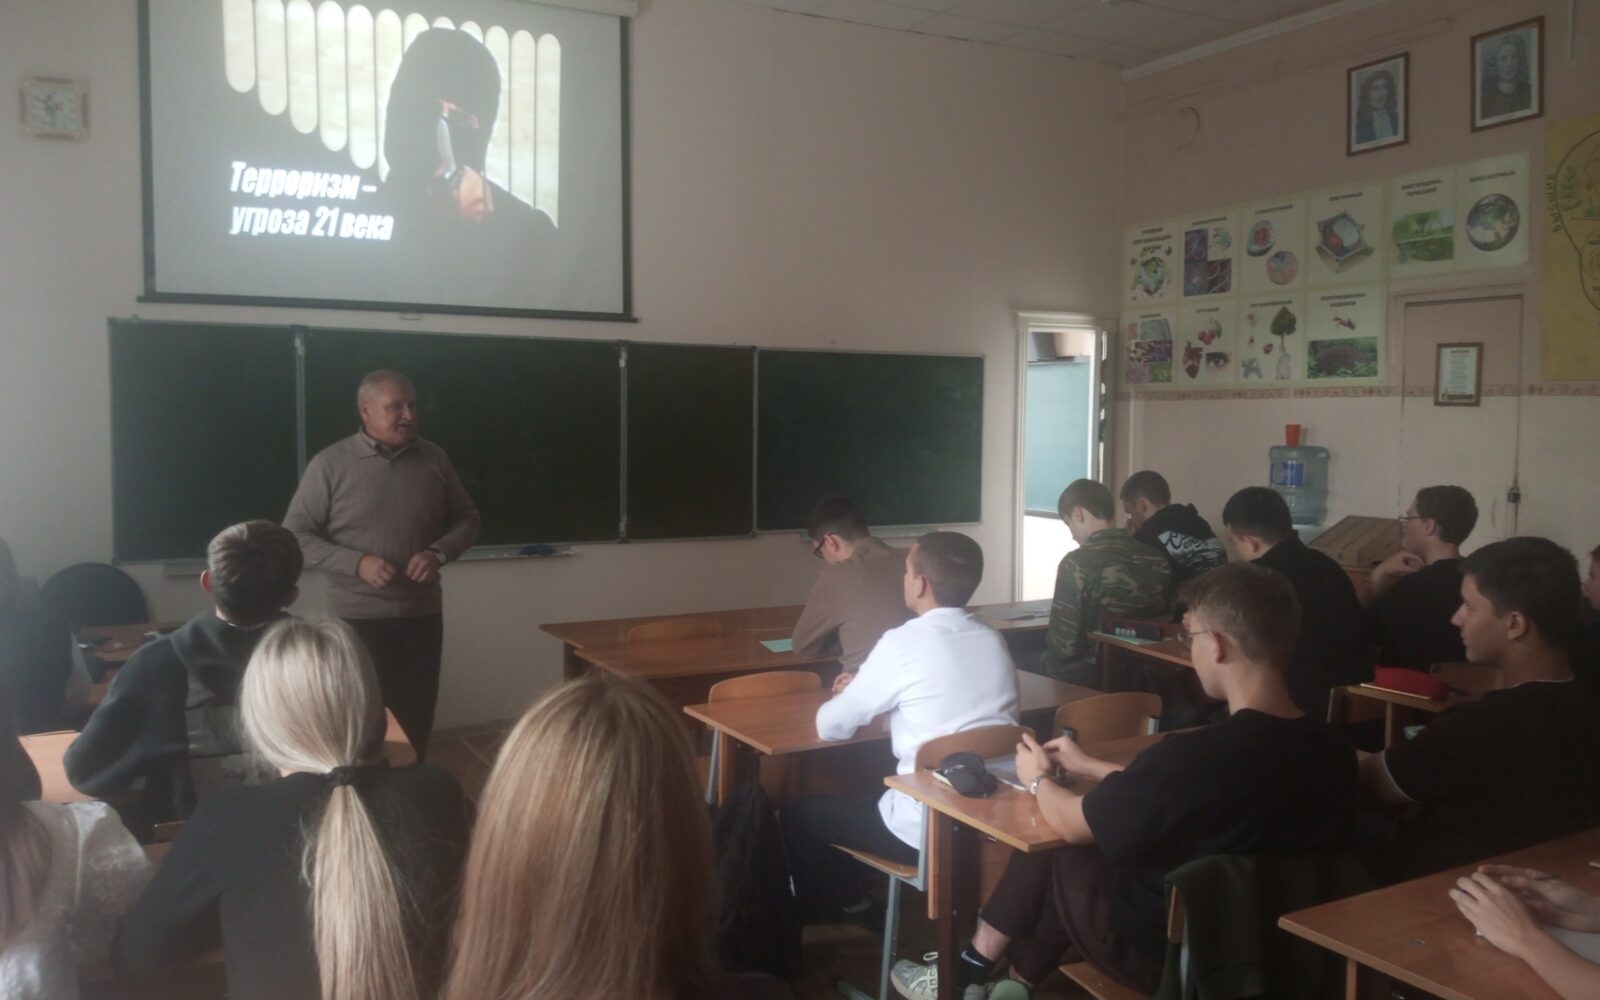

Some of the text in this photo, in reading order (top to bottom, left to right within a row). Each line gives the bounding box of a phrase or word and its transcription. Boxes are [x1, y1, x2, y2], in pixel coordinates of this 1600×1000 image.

[230, 161, 361, 200] Терроризм
[229, 206, 395, 241] угроза 21 века
